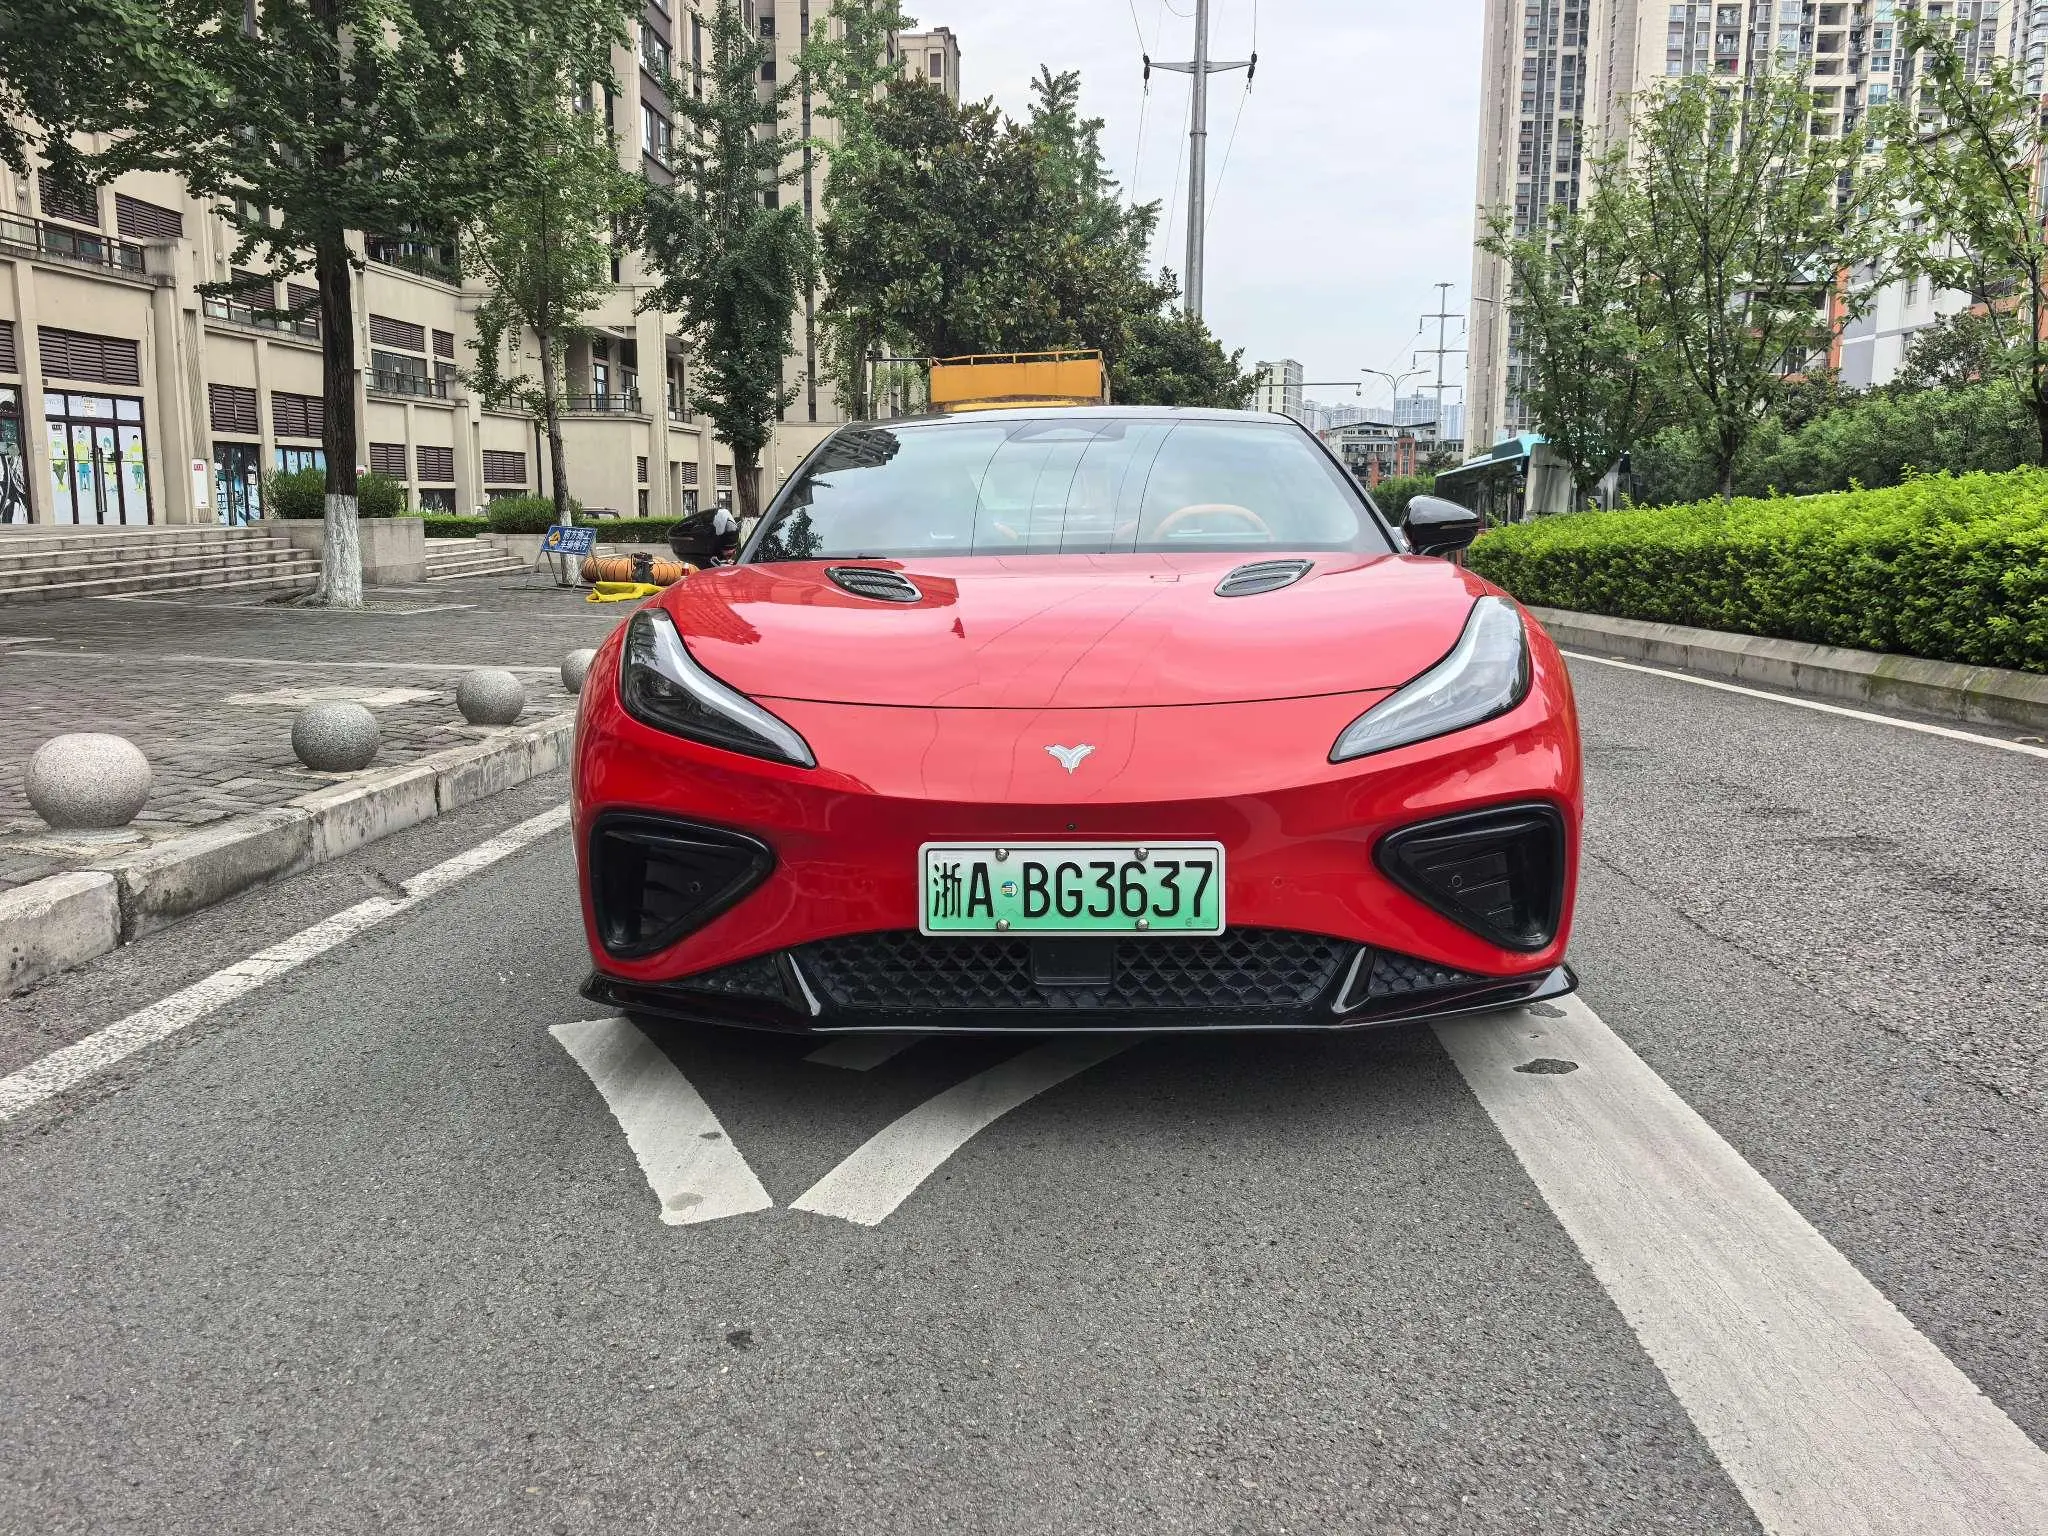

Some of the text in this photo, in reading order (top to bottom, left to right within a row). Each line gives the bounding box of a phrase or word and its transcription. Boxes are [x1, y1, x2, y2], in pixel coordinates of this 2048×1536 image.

[563, 529, 592, 540] 前方施工
[1023, 861, 1213, 918] BG3637
